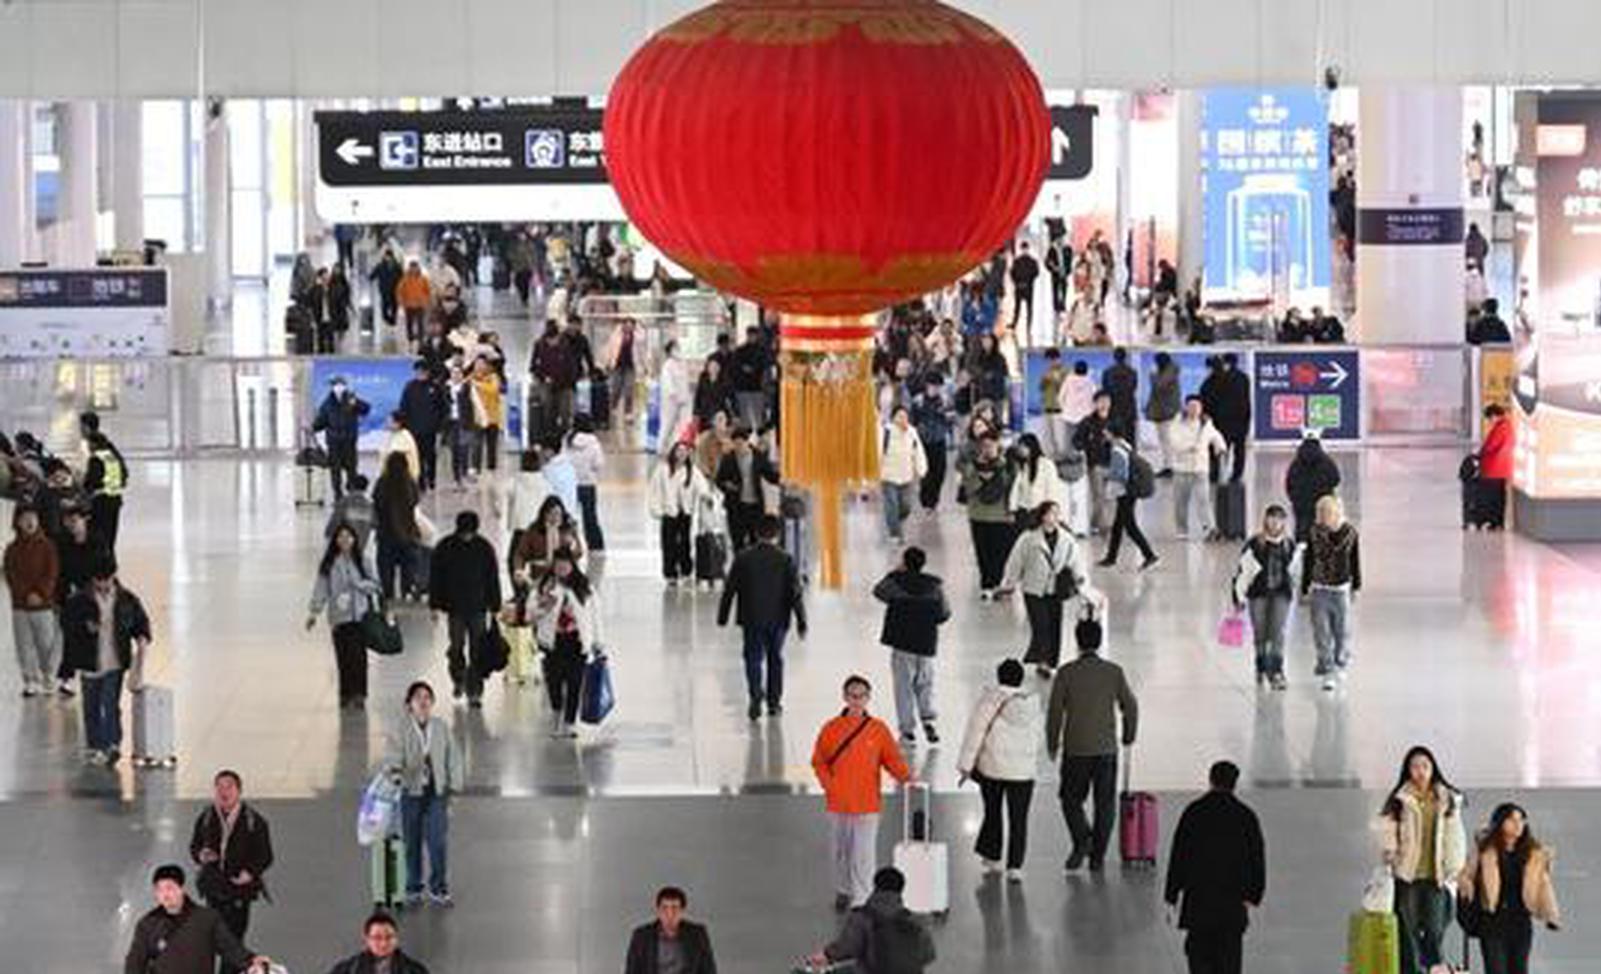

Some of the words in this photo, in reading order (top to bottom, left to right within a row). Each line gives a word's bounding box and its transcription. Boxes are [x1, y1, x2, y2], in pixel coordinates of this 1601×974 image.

[424, 131, 502, 153] 东进站口
[424, 155, 451, 168] East
[454, 155, 512, 168] Entrance
[569, 155, 597, 168] East
